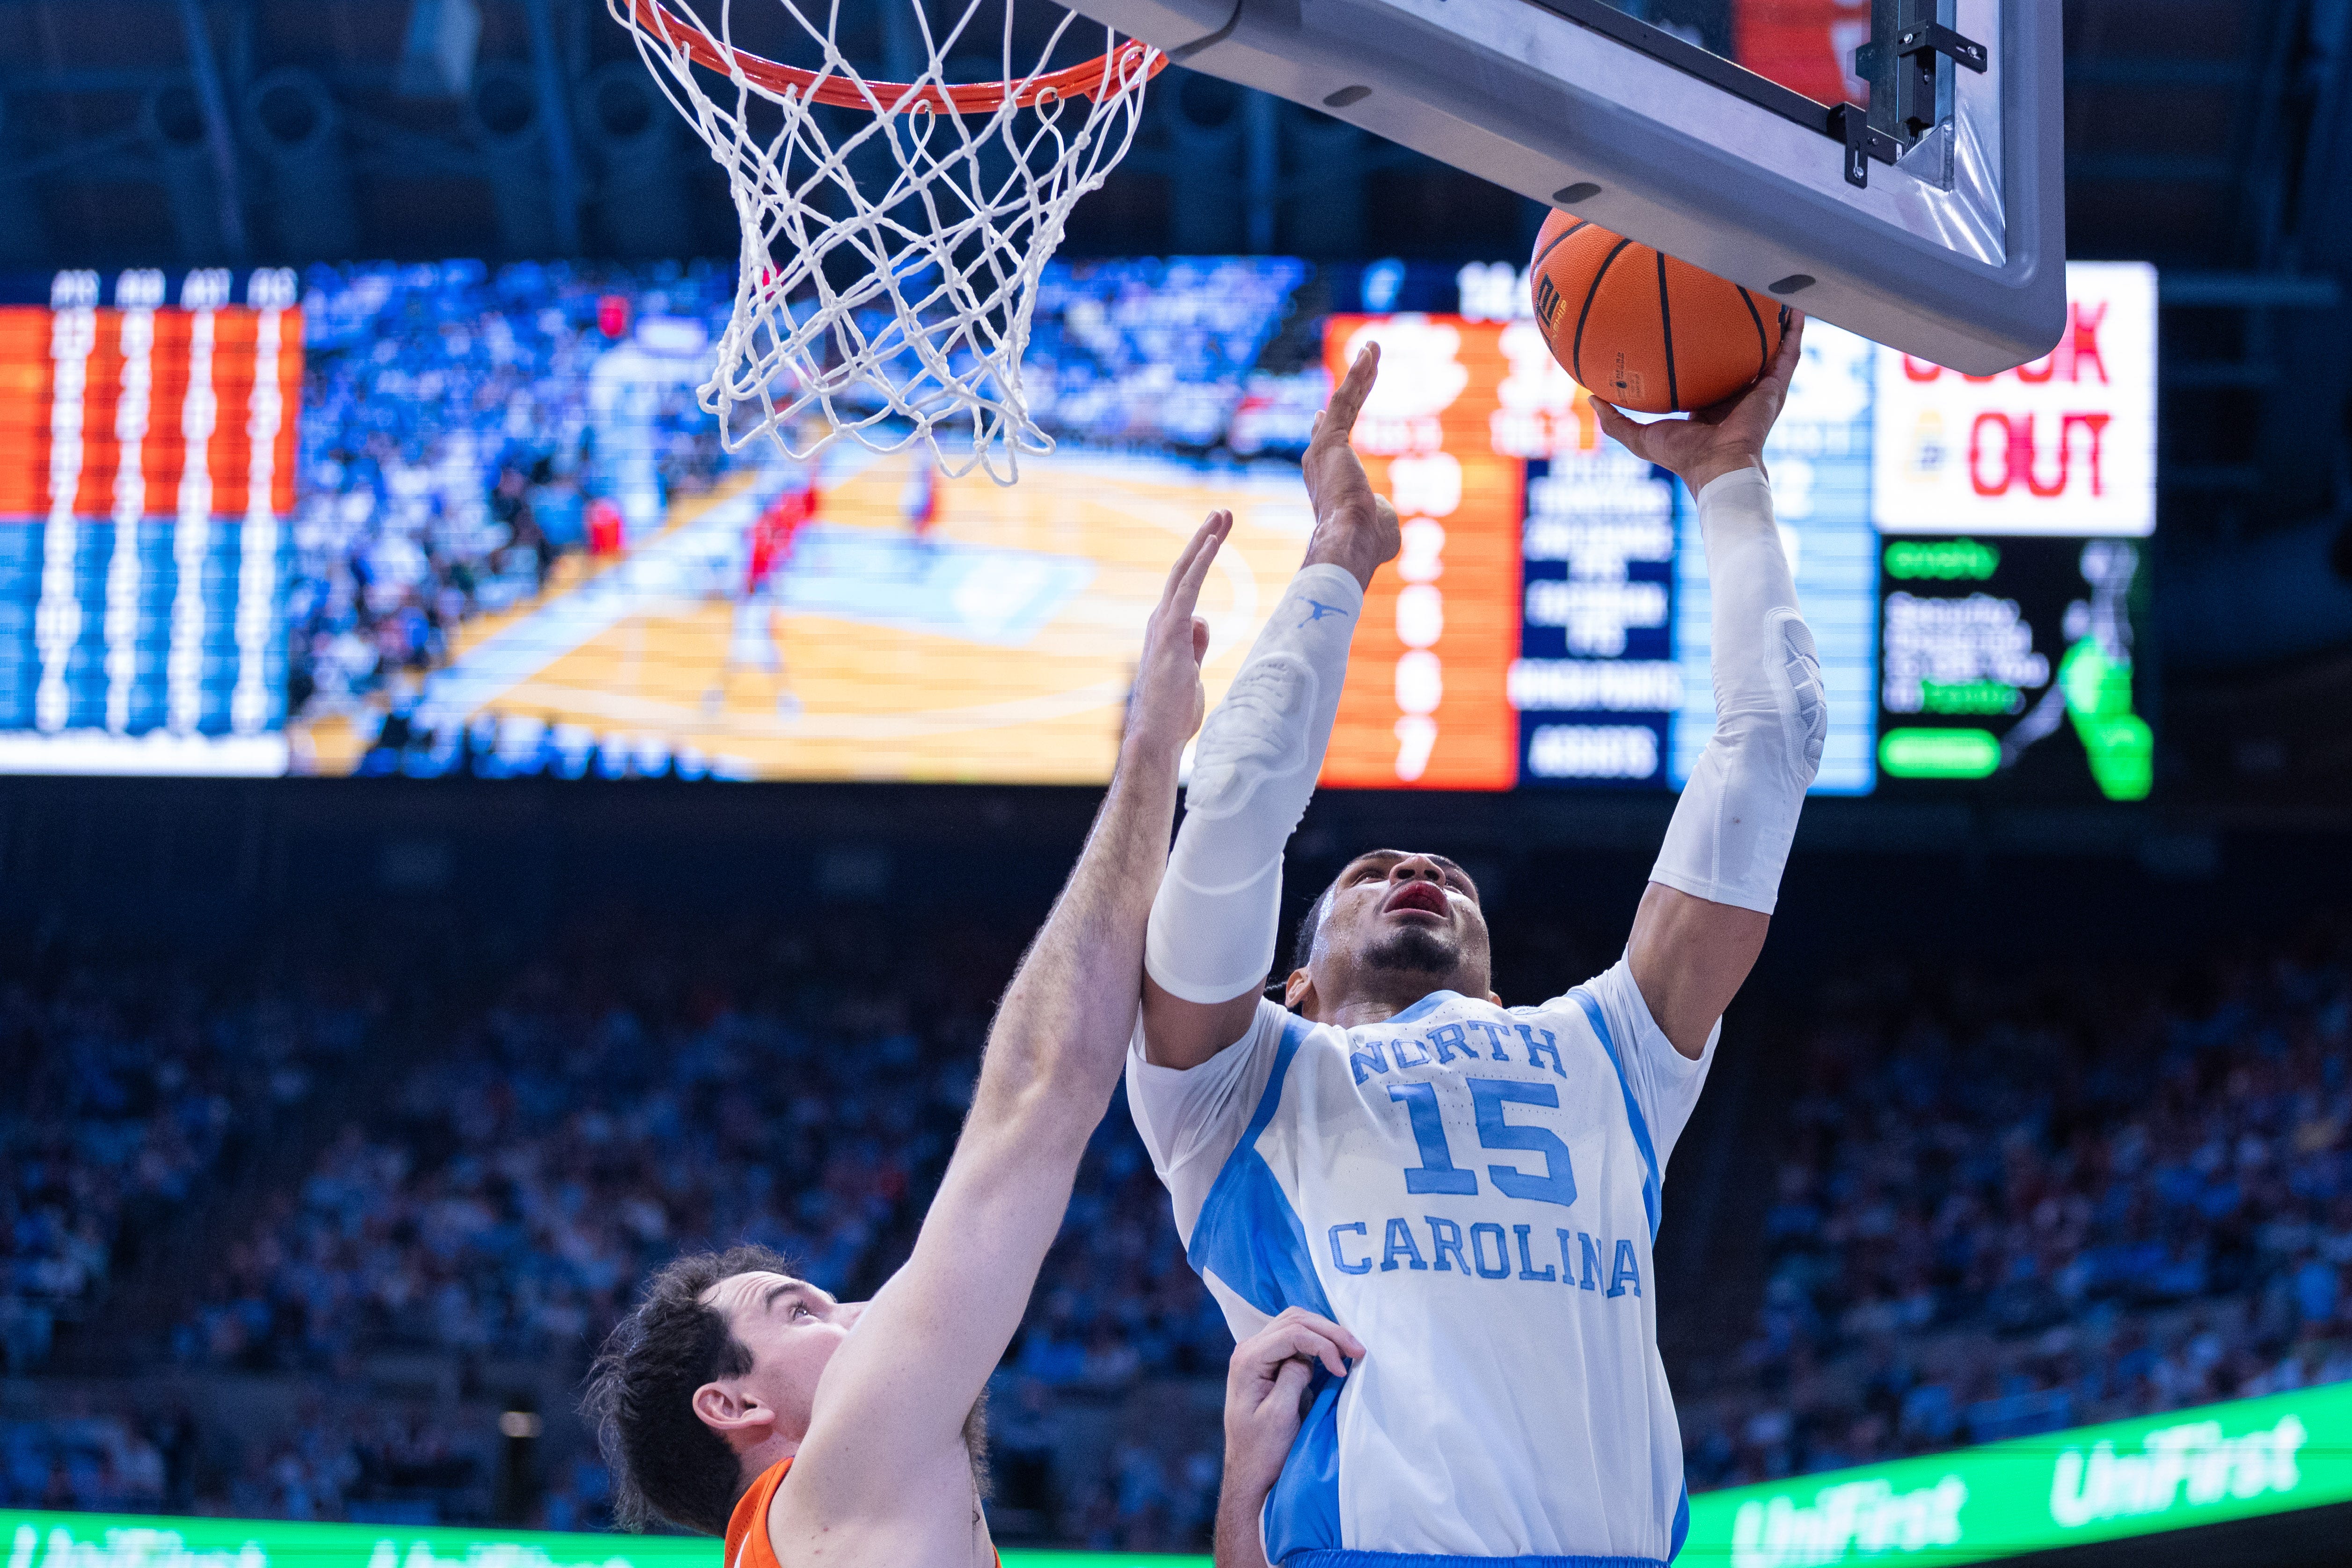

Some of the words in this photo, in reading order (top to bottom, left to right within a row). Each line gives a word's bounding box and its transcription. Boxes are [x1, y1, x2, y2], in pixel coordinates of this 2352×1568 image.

[1970, 411, 2111, 497] OUT
[1350, 1020, 1567, 1085] NORTH
[1387, 1077, 1578, 1207] 15
[1328, 1215, 1641, 1298] CAROLINA
[2051, 1415, 2307, 1527] UniFirst
